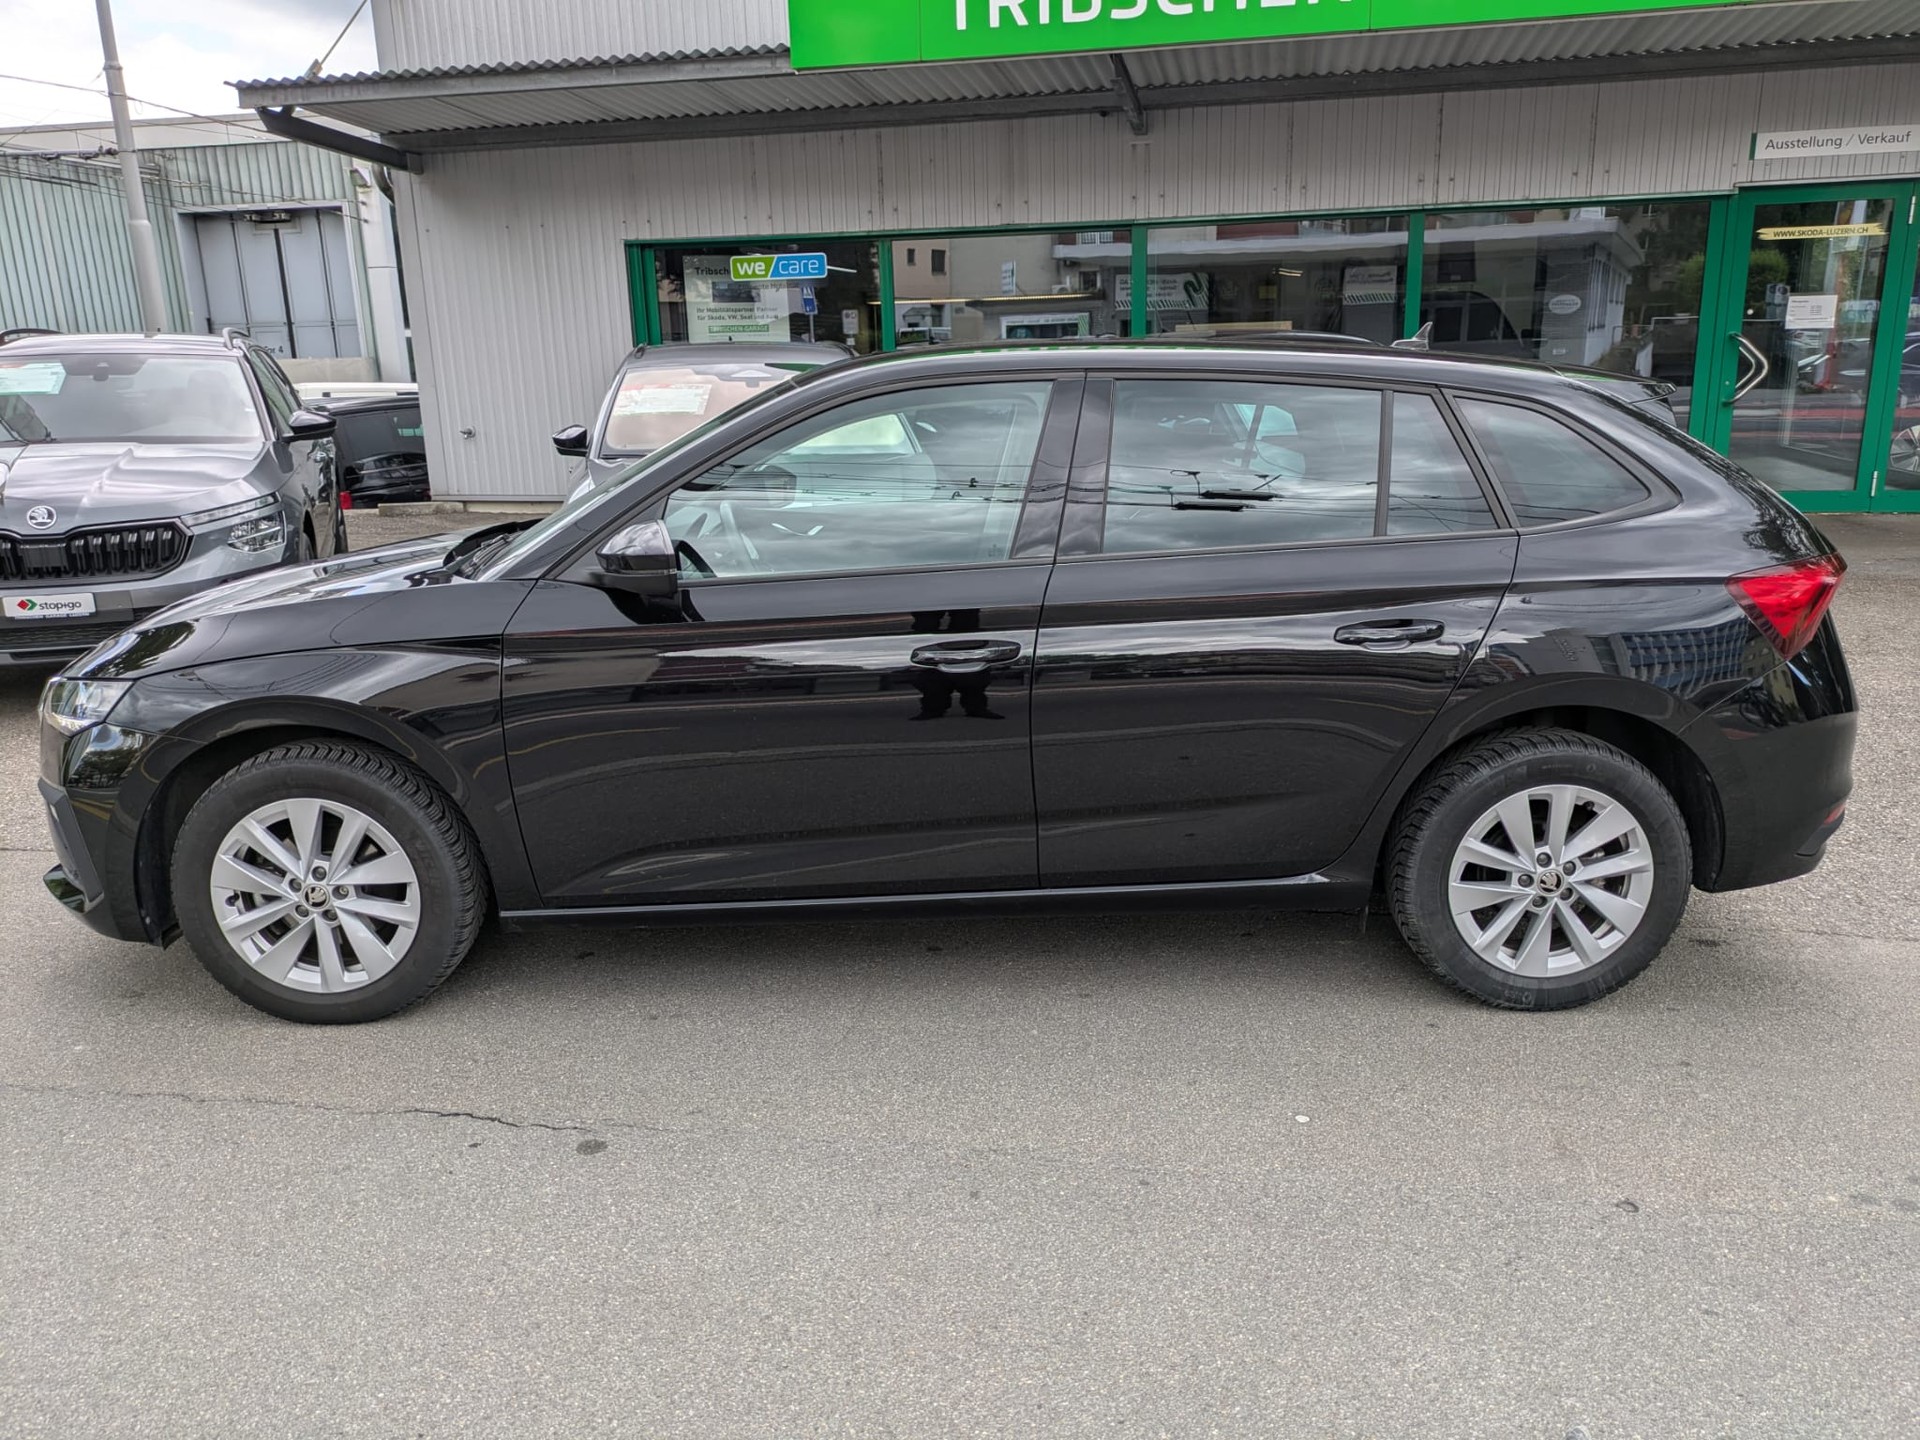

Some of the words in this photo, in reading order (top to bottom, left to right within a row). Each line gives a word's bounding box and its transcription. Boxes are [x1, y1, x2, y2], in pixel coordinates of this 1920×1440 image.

[1765, 136, 1842, 151] Ausstellung
[1858, 131, 1911, 145] Verkauf
[694, 266, 729, 276] Tribsch
[737, 261, 766, 276] we
[779, 259, 819, 274] care
